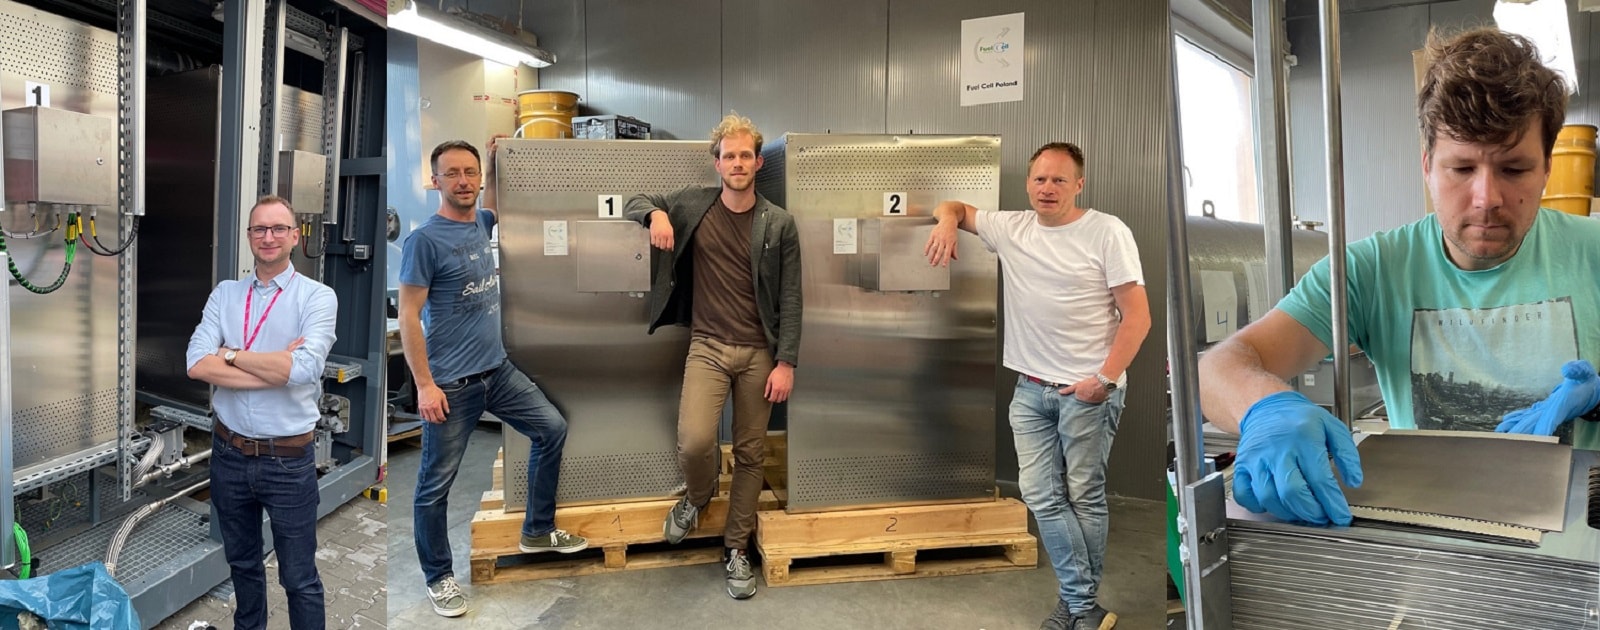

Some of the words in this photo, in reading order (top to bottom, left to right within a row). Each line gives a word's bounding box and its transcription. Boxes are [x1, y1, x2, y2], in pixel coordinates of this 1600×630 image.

[979, 45, 994, 53] Fuel
[966, 84, 980, 92] Fuel
[981, 82, 994, 90] Cell
[995, 80, 1018, 88] Poland
[32, 85, 42, 106] 1
[605, 197, 615, 216] 1
[890, 194, 902, 214] 2
[1216, 311, 1228, 336] 4
[611, 514, 625, 531] 1
[885, 517, 898, 532] 2
